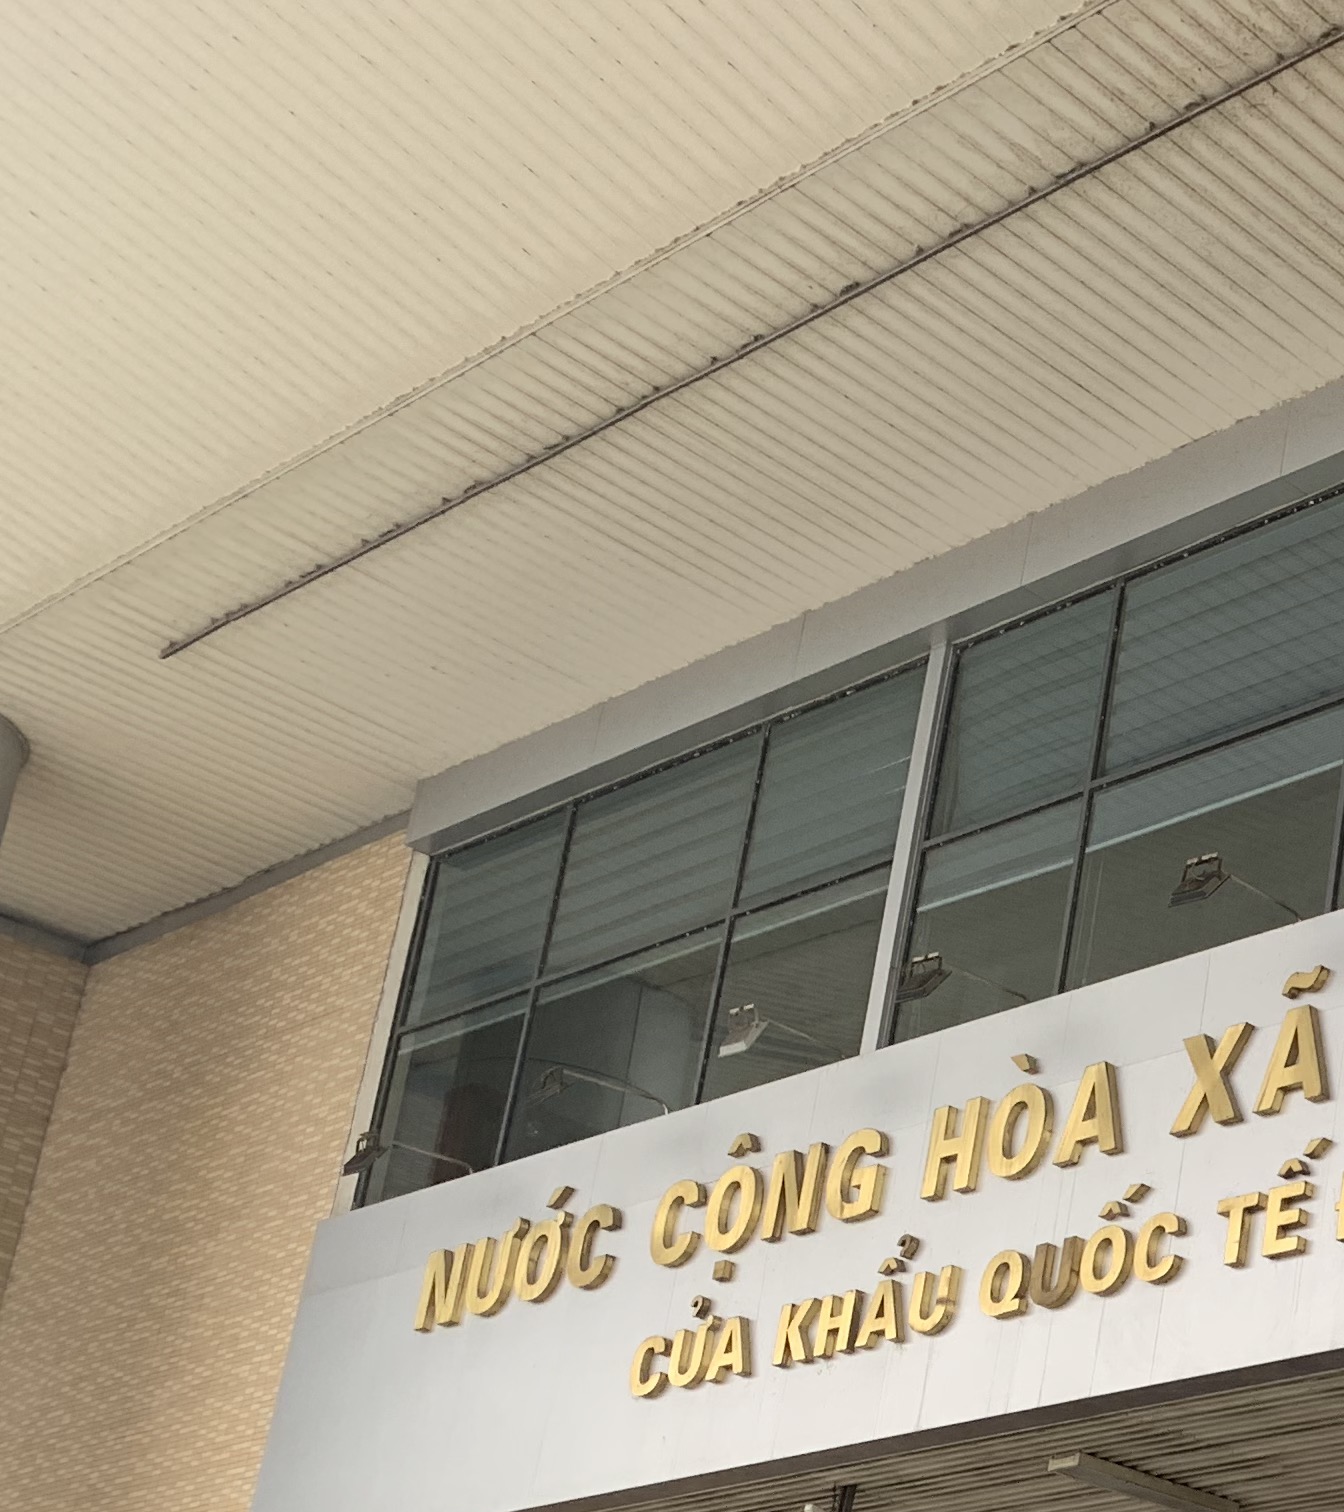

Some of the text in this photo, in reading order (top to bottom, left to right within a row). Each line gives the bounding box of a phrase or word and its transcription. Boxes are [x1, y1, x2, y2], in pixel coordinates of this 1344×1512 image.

[413, 1185, 622, 1332] NƯỚC
[650, 1132, 889, 1283] CỘNG
[920, 1053, 1123, 1201] HÒA
[1169, 964, 1331, 1138] XÃ
[630, 1295, 752, 1398] CỬA
[771, 1234, 963, 1368] KHẨU
[978, 1183, 1188, 1319] QUỐC
[1216, 1136, 1333, 1268] TẾ
